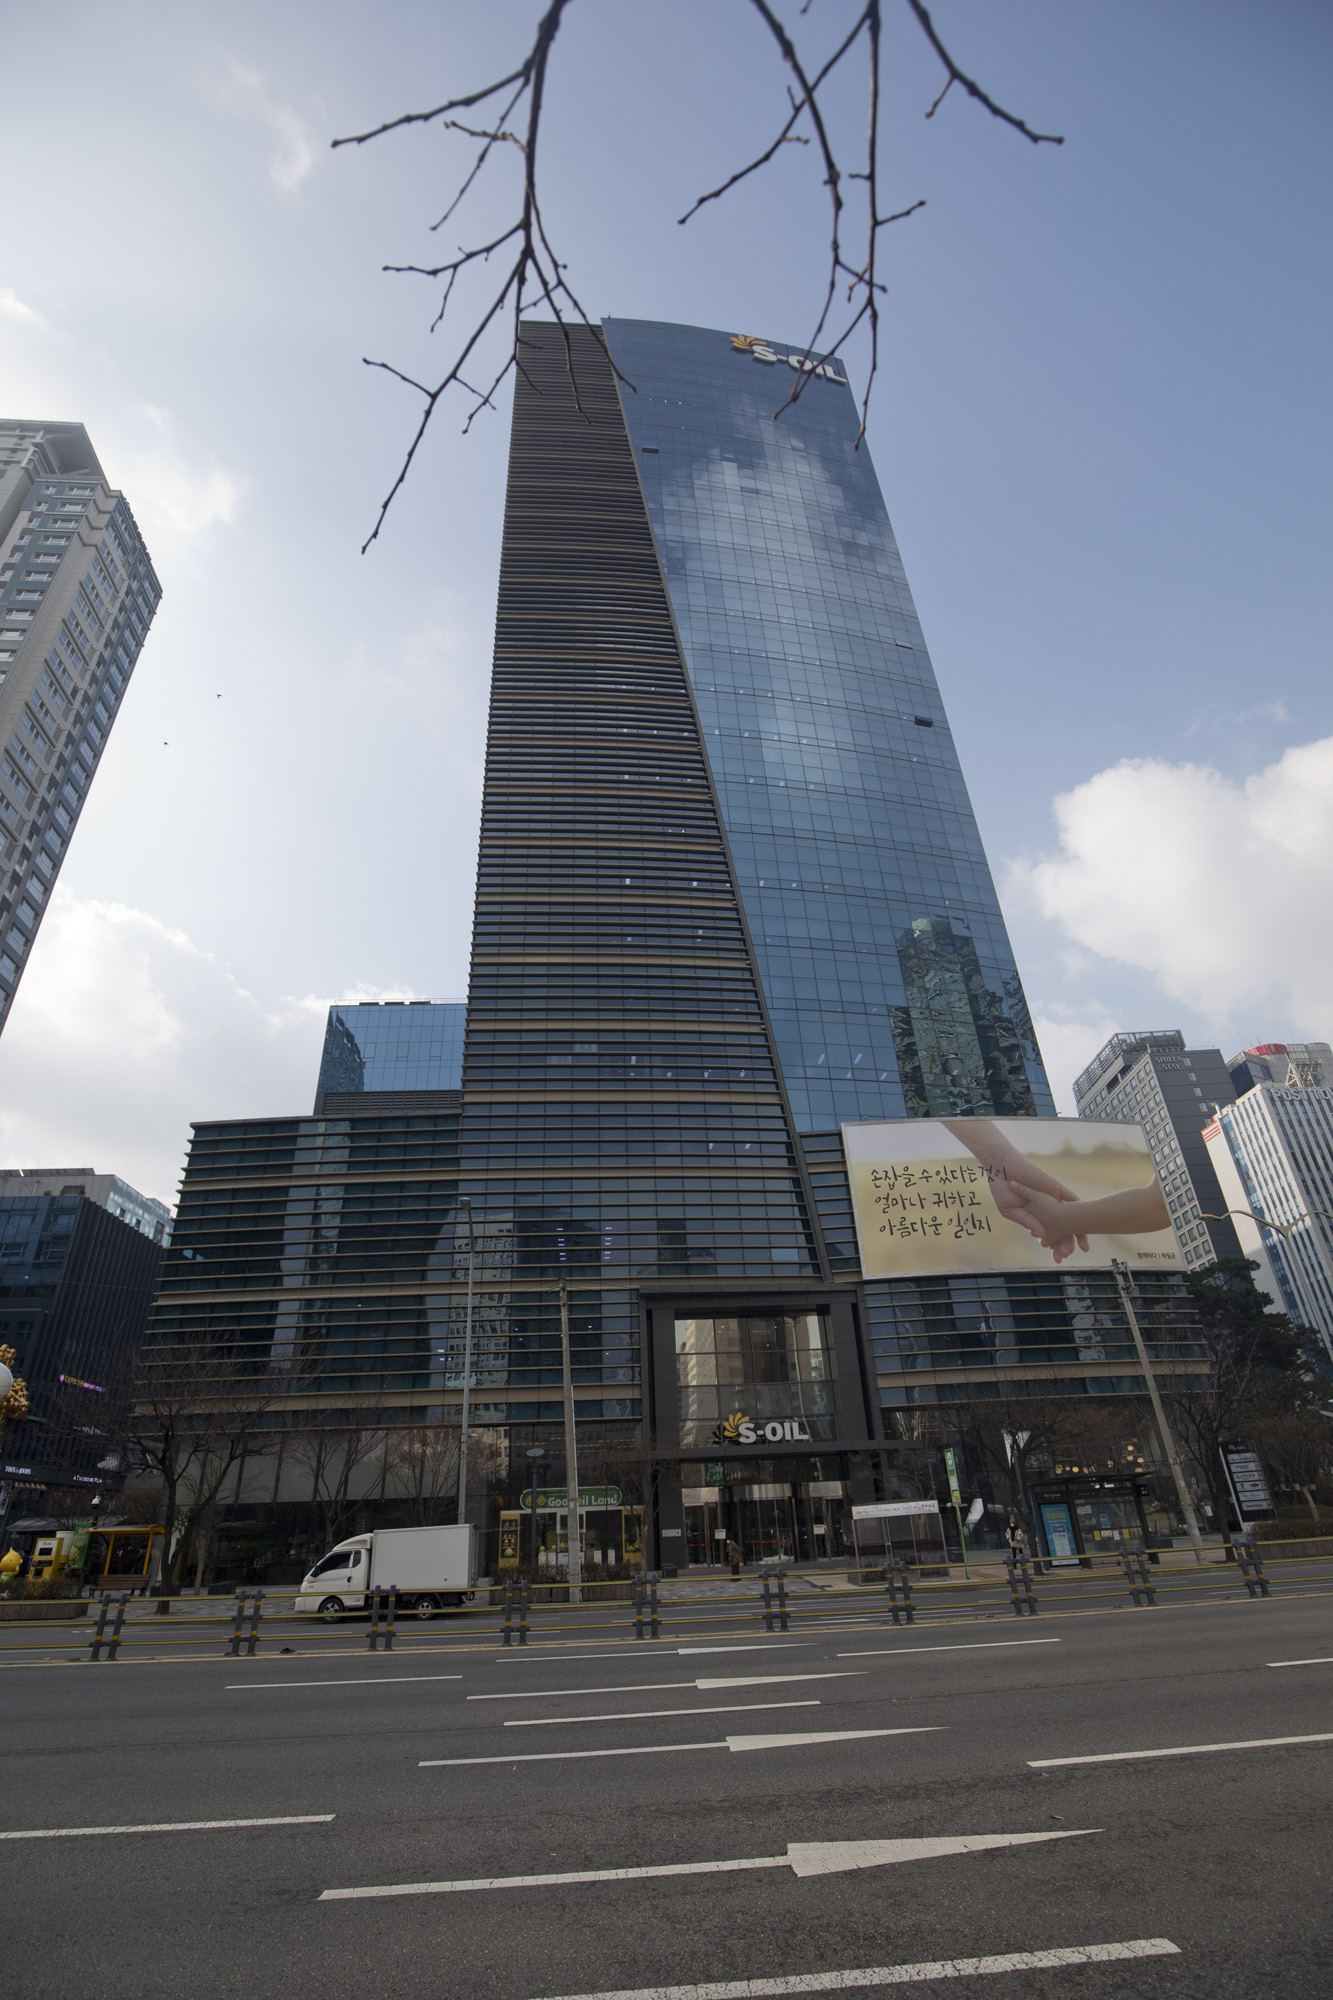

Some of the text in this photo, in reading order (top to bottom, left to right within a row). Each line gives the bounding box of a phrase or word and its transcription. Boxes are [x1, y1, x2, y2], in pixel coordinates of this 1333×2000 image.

[752, 345, 847, 384] S-OIL
[1271, 1087, 1333, 1100] POST TO
[871, 1165, 917, 1190] 손잡을
[875, 1190, 981, 1214] 얼마나 귀하고
[879, 1211, 992, 1238] 아름다운 일인지
[738, 1422, 809, 1444] S-OIL
[591, 1494, 618, 1505] Land
